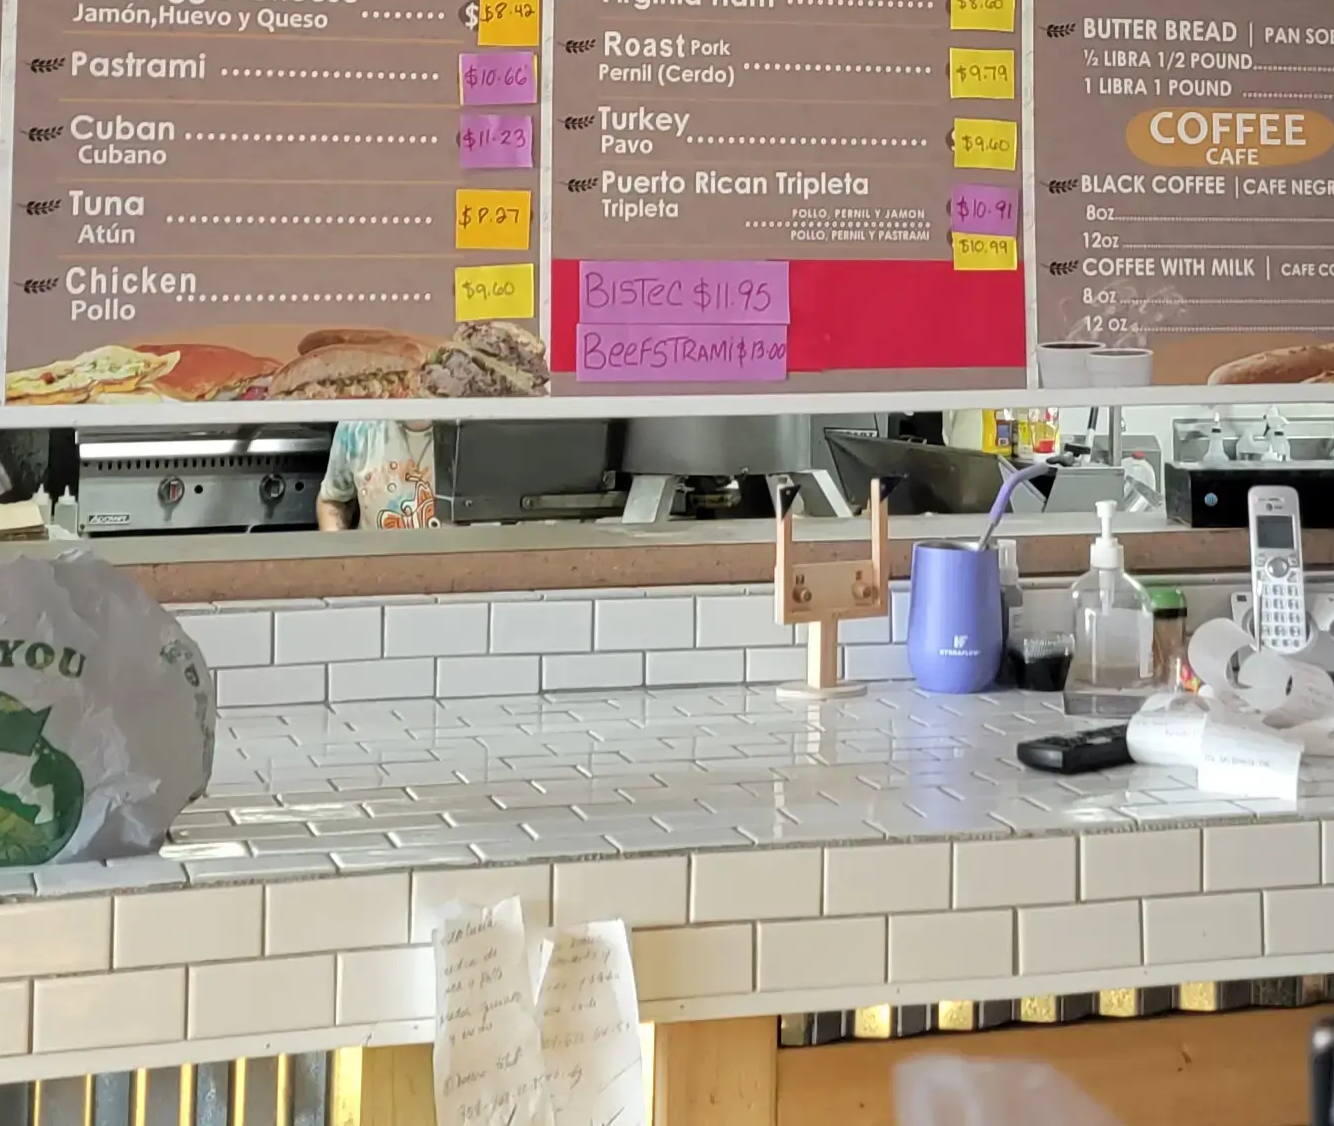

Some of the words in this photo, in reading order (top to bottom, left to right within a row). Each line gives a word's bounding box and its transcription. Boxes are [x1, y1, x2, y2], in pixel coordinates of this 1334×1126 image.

[257, 8, 328, 32] Queso
[479, 2, 535, 23] $8.42
[1084, 18, 1157, 40] BUTTER
[1166, 20, 1237, 42] BREAD
[1265, 27, 1300, 44] PAN
[605, 31, 685, 58] Roast
[691, 39, 730, 55] Pork
[72, 51, 206, 79] Pastrami
[1104, 50, 1151, 67] LIBRA
[1158, 51, 1185, 70] 1/2
[599, 64, 651, 81] Pernil
[658, 64, 734, 87] (Cerdo)
[956, 65, 1007, 82] $9.79
[1100, 77, 1147, 95] LIBRA
[1169, 79, 1232, 96] POUND
[71, 115, 174, 140] Cuban
[598, 106, 690, 137] Turkey
[1150, 111, 1306, 145] COFFEE
[462, 127, 526, 150] $11.23
[602, 135, 653, 154] Pavo
[79, 144, 166, 164] Cubano
[1206, 148, 1259, 165] CAFE
[602, 170, 685, 193] Puerto
[696, 170, 767, 194] Rican
[776, 171, 868, 200] Tripleta
[1082, 175, 1145, 193] BLACK
[1152, 175, 1225, 194] COFFEE
[1243, 179, 1286, 195] CAFE
[69, 190, 144, 216] Tuna
[602, 198, 678, 222] Tripleta
[885, 209, 925, 219] JAMON
[957, 196, 1012, 222] $10.91
[78, 223, 135, 243] Atún
[831, 230, 865, 240] PERNIL
[878, 230, 929, 241] PASTRAMI
[959, 239, 1007, 254] $10.99
[1083, 258, 1155, 276] COFFEE
[1161, 258, 1205, 276] WITH
[1211, 258, 1255, 276] MILK
[1281, 263, 1315, 276] CAFE
[66, 266, 196, 294] Chicken
[693, 278, 771, 313] $11.95
[71, 298, 135, 320] Pollo
